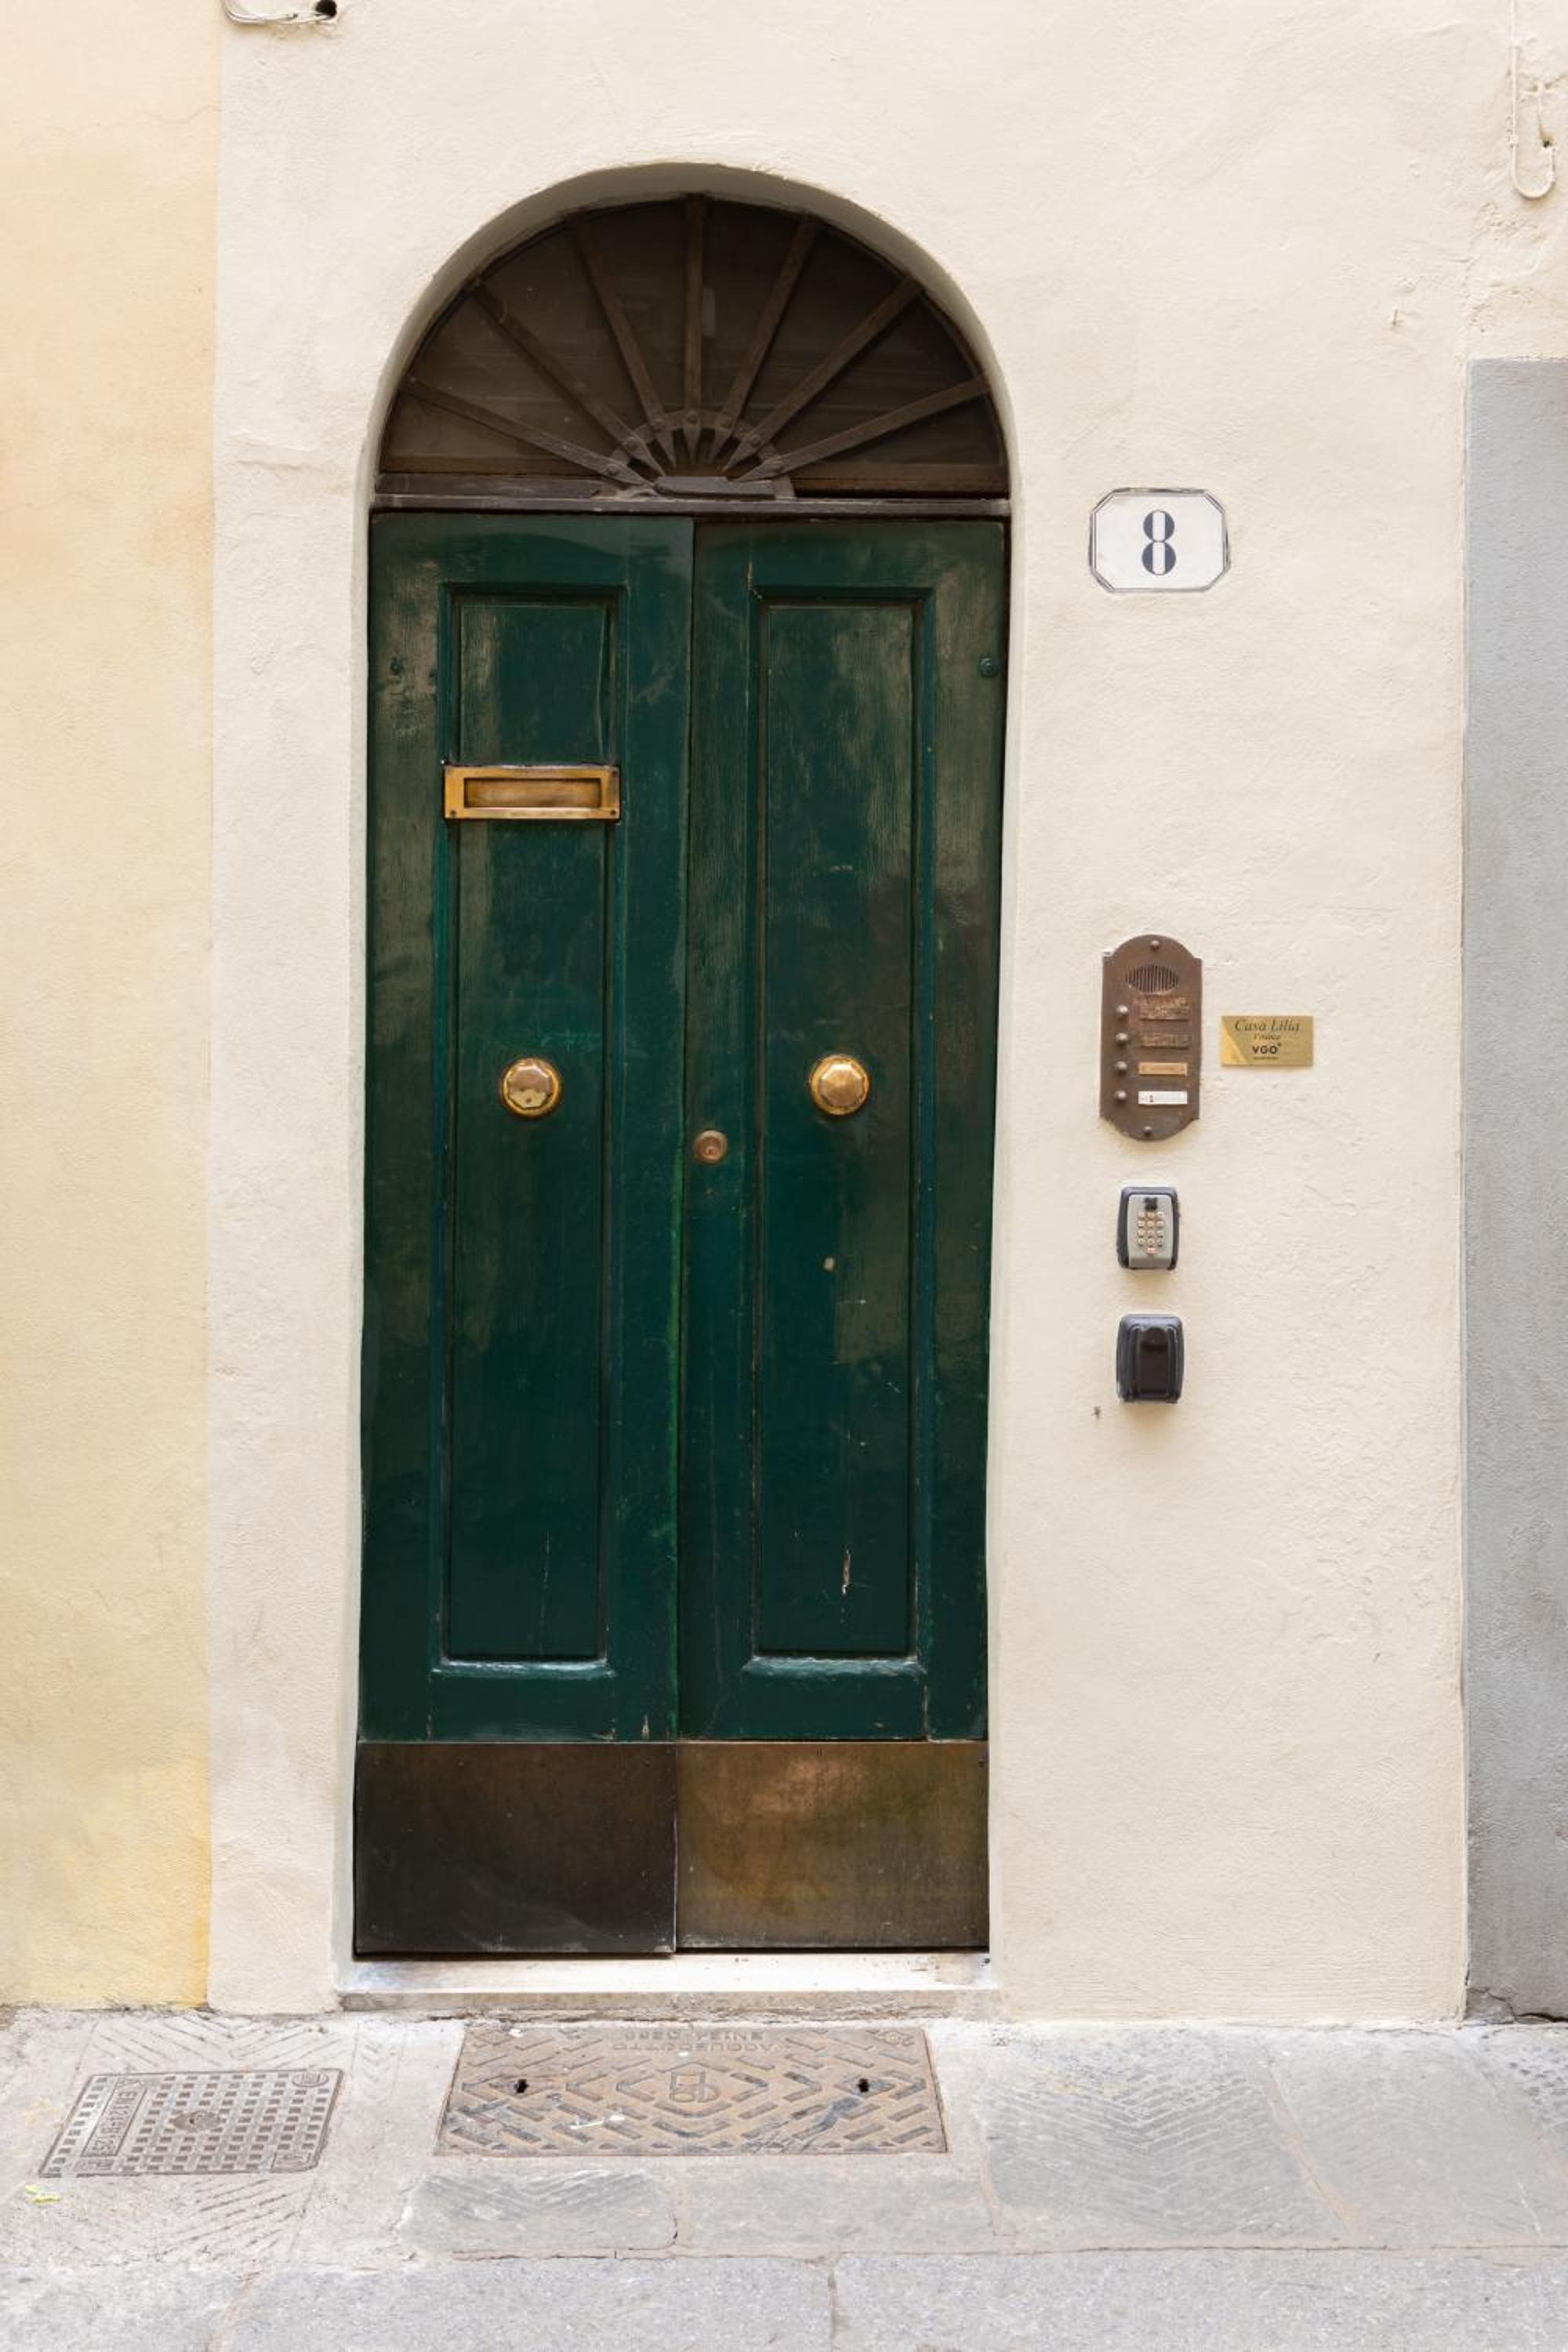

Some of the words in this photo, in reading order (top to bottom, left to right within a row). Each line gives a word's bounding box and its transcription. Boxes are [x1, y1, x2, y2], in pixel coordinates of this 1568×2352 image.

[1142, 510, 1176, 575] 8
[1235, 1018, 1266, 1032] Casa
[1270, 1018, 1300, 1032] Lilia
